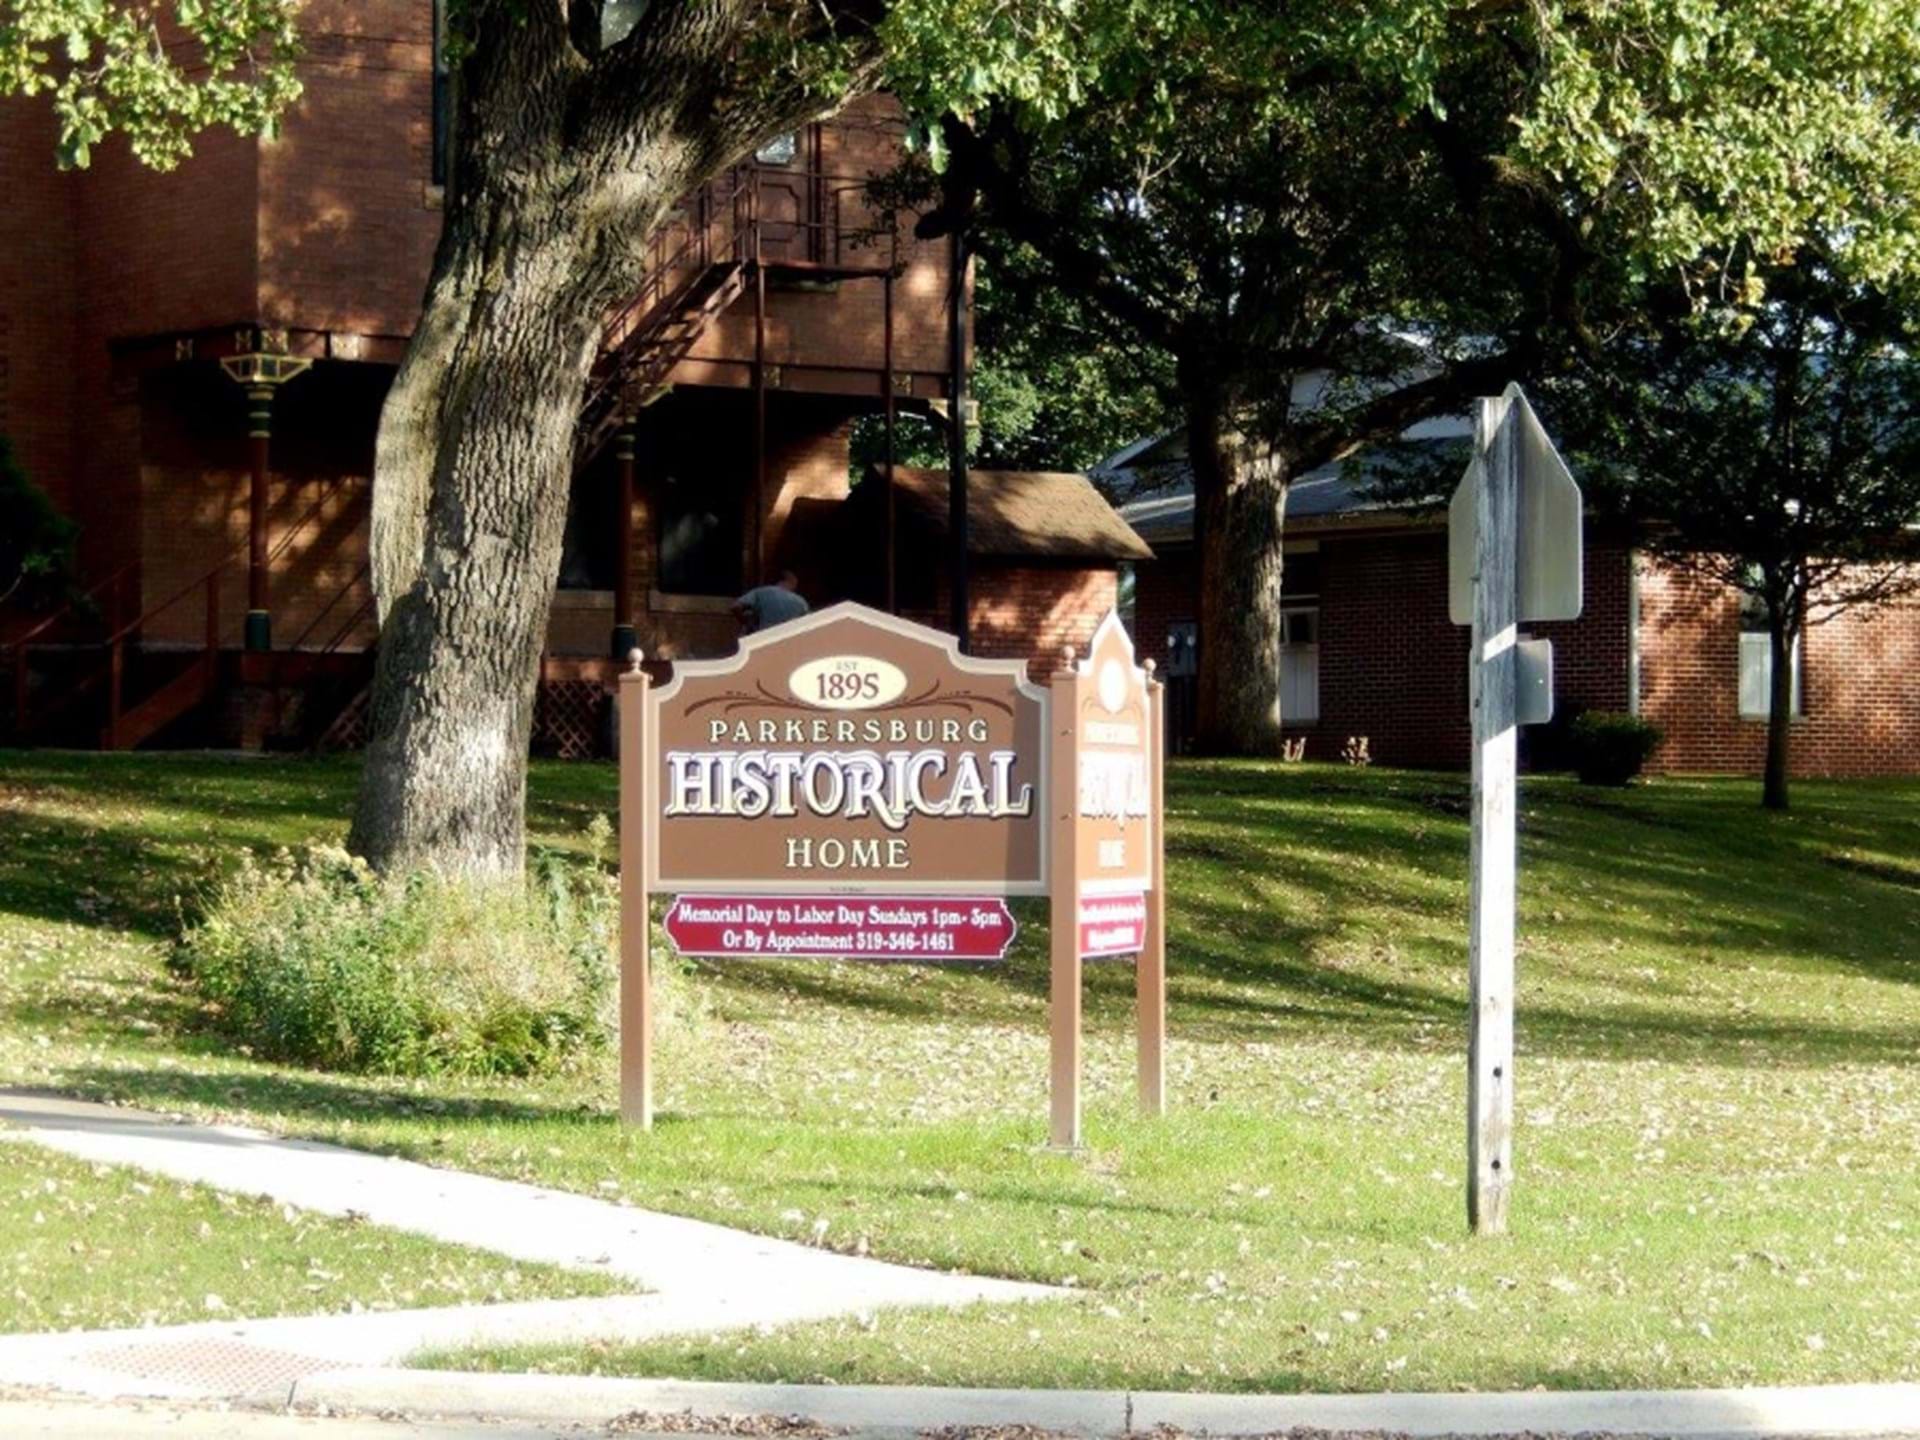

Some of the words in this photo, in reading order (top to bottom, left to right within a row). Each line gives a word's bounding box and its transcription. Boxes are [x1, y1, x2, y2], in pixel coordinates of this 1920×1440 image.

[836, 661, 858, 671] EST
[817, 672, 879, 700] 1895
[710, 719, 988, 743] PARKERSBURG
[664, 750, 1033, 829] HISTORICAL
[785, 838, 911, 868] HOME
[679, 904, 743, 923] Memorial
[746, 904, 773, 926] Day
[777, 905, 791, 923] to
[794, 905, 834, 924] Labor
[838, 905, 865, 927] Day
[868, 905, 929, 928] Sundays
[723, 930, 742, 948] Or
[745, 930, 763, 951] By
[766, 931, 853, 951] Appointment
